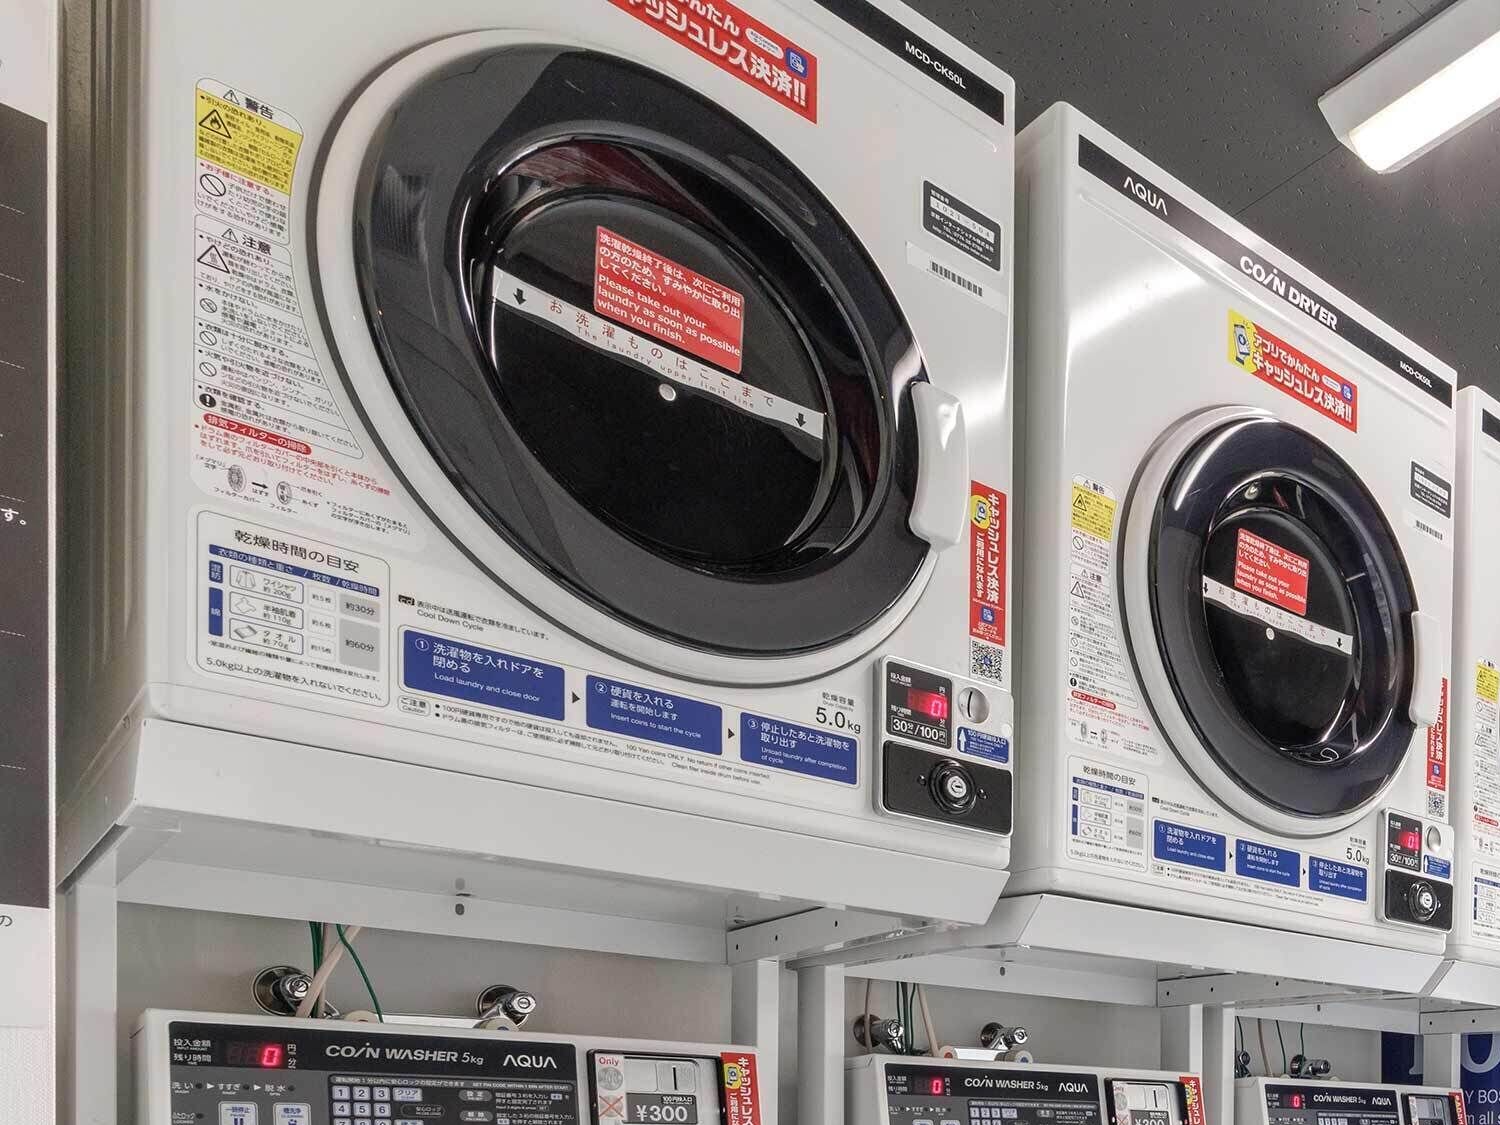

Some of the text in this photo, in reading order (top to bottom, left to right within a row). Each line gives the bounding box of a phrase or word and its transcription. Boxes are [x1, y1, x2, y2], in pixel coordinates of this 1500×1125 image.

[682, 0, 740, 36] んたん
[905, 41, 967, 90] MCD-CK50L
[245, 97, 274, 120] 警告
[1123, 175, 1168, 217] AQUA
[242, 233, 272, 255] 注意
[600, 258, 667, 297] してください。
[600, 246, 741, 320] の方のため、すみやかに取り出
[599, 274, 708, 329] Please take out your
[1287, 289, 1339, 331] DRYER
[598, 286, 741, 357] laundry as soon as possible
[598, 299, 686, 344] when you finish.
[549, 299, 775, 408] お洗濯ものはここまで
[1252, 330, 1322, 384] アプリでかんたん
[606, 338, 653, 366] laundry
[701, 379, 727, 397] limit
[1251, 350, 1353, 425] キャッシュレス決済!!
[234, 529, 361, 574] 乾燥時間の目安
[417, 609, 484, 633] Cool Down Cycle
[432, 641, 545, 679] 洗濯物を入れドアを
[432, 655, 471, 674] 閉める
[434, 672, 540, 702] Load laundry and close door
[610, 684, 675, 710] 硬貨を入れる
[610, 699, 679, 721] 運転を開始します
[610, 712, 630, 723] Insert
[631, 717, 649, 728] coins
[658, 724, 673, 733] start
[674, 726, 684, 735] the
[685, 729, 702, 739] cycle
[760, 721, 851, 752] 停止したあと洗濯物を
[760, 732, 798, 749] 取り出す
[173, 1038, 212, 1048] 投入金額
[173, 1053, 212, 1063] 残り時間
[261, 1046, 281, 1067] 0
[385, 1047, 459, 1063] WASHER
[461, 1052, 484, 1066] 5kg
[502, 1053, 558, 1069] AQUA
[598, 1056, 620, 1067] Only
[337, 1089, 344, 1098] 1
[358, 1089, 366, 1098] 2
[378, 1089, 386, 1098] 3
[995, 1079, 1035, 1090] WASHER
[1057, 1082, 1089, 1094] AQUA
[338, 1105, 346, 1114] 4
[359, 1105, 367, 1114] 5
[379, 1105, 386, 1114] 6
[1332, 1095, 1358, 1104] WASHER
[1371, 1097, 1392, 1106] AQUA
[635, 1104, 689, 1122] ¥300
[1478, 1110, 1494, 1125] all
